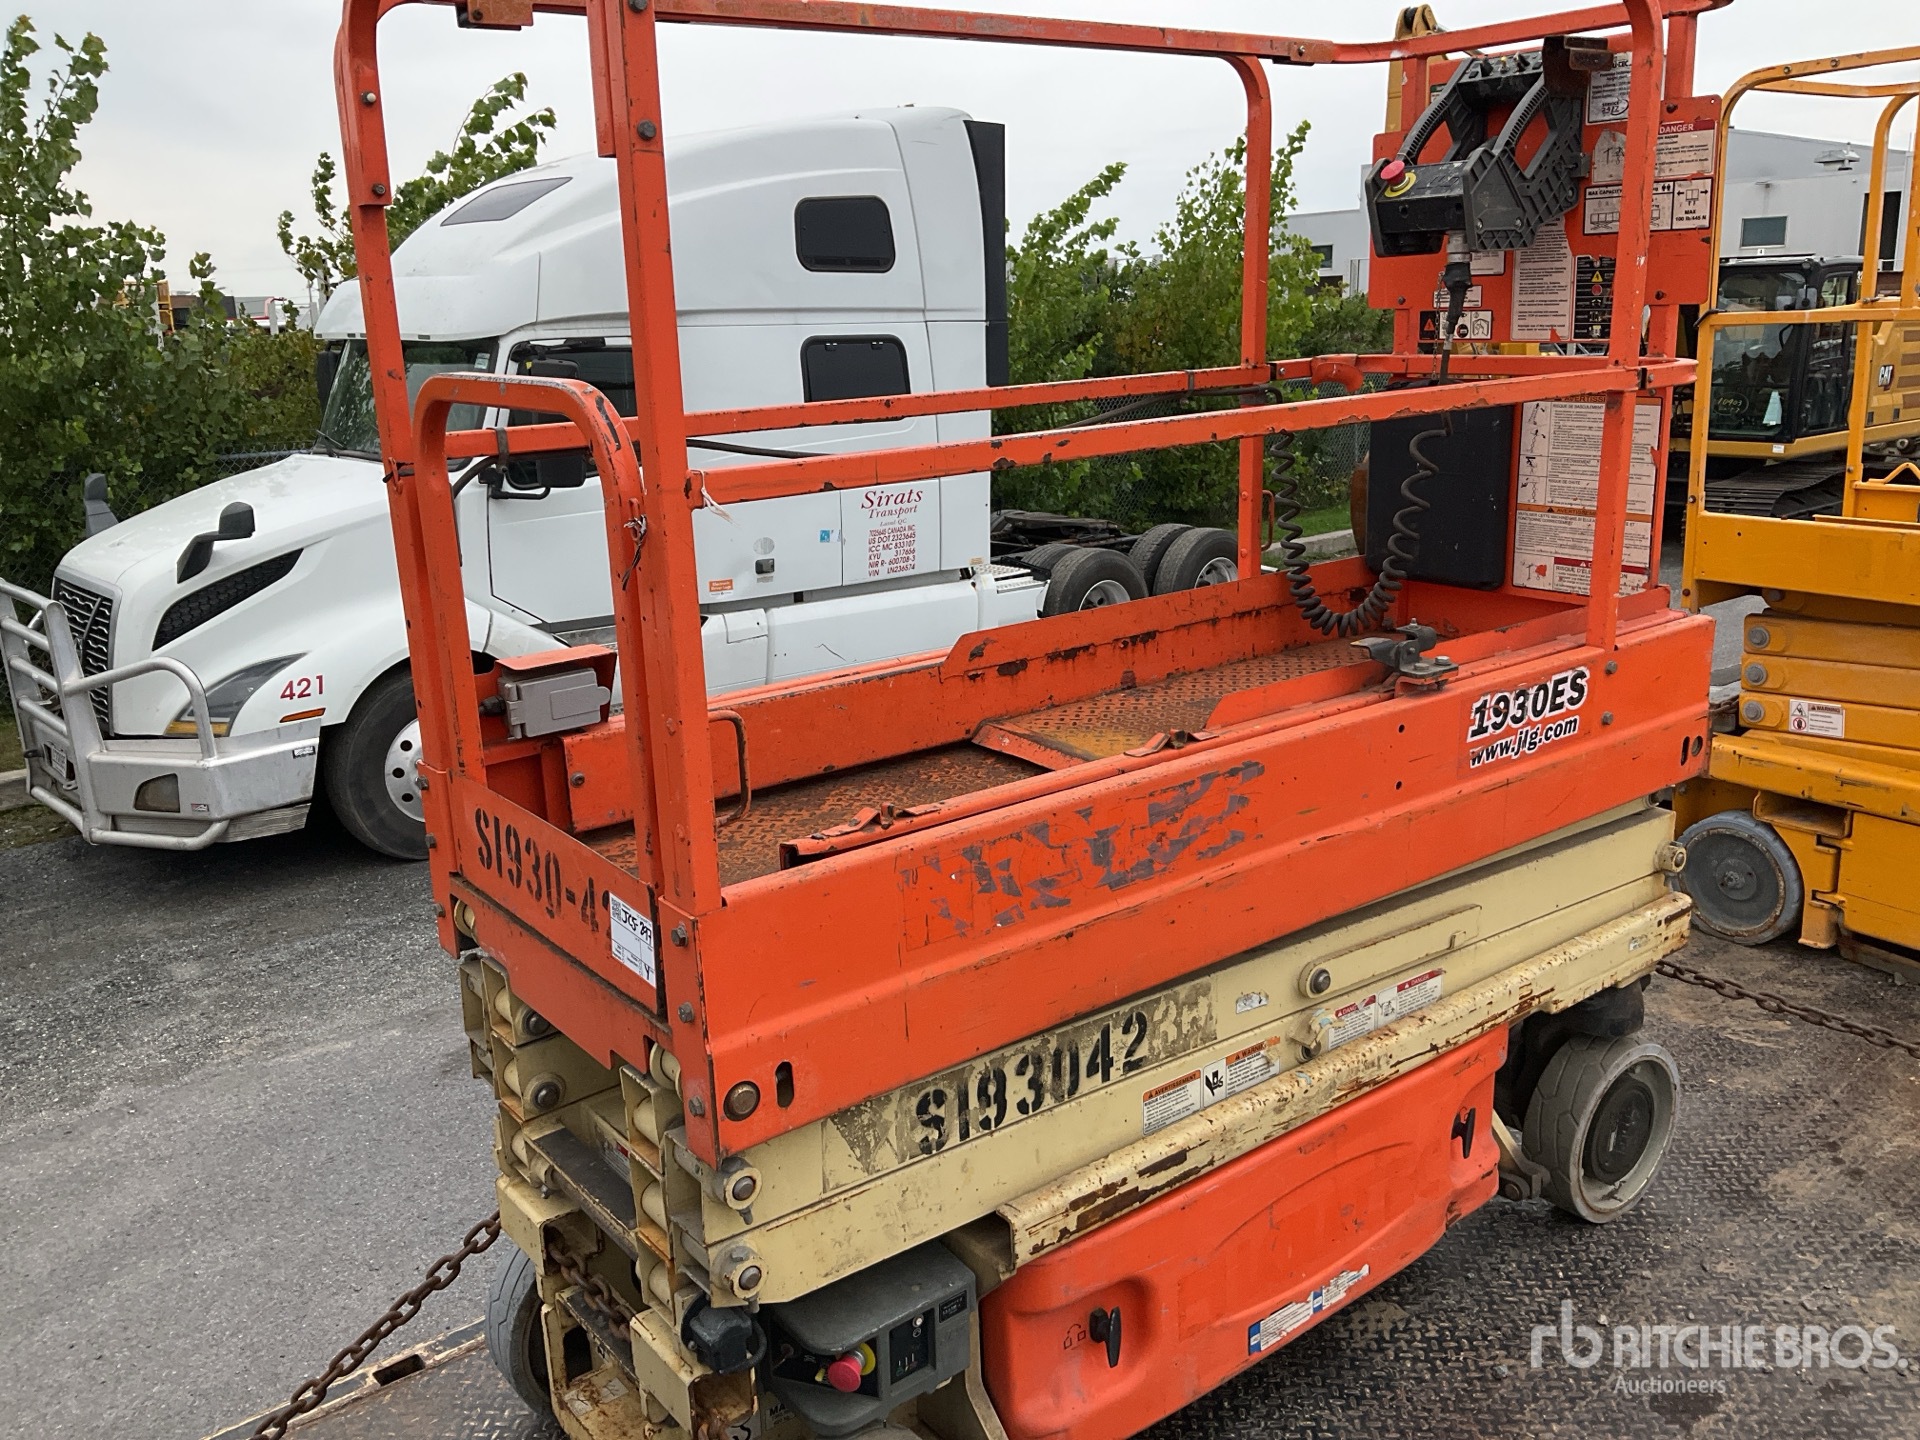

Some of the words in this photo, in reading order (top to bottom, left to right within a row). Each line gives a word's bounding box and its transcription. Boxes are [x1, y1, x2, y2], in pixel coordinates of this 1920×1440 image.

[1659, 123, 1694, 134] DANGER
[1879, 365, 1893, 387] CAT
[861, 489, 923, 509] Sirats
[869, 505, 918, 518] Transport
[887, 525, 907, 535] CANADA
[907, 524, 915, 532] INC
[868, 536, 876, 545] US
[877, 535, 890, 544] DOT
[891, 532, 916, 542] 2323645
[868, 544, 880, 553] ICC
[882, 542, 895, 551] MC
[894, 539, 916, 549] 833107
[868, 552, 881, 561] KYU
[894, 547, 916, 557] 317656
[868, 560, 879, 569] NIR
[868, 569, 880, 577] VIN
[280, 674, 325, 701] 421
[1470, 669, 1588, 738] 1930ES
[1816, 705, 1841, 714] WARNING
[1470, 715, 1580, 767] www.jlg.com
[474, 807, 610, 937] S1930-4
[1410, 973, 1431, 986] DANGER
